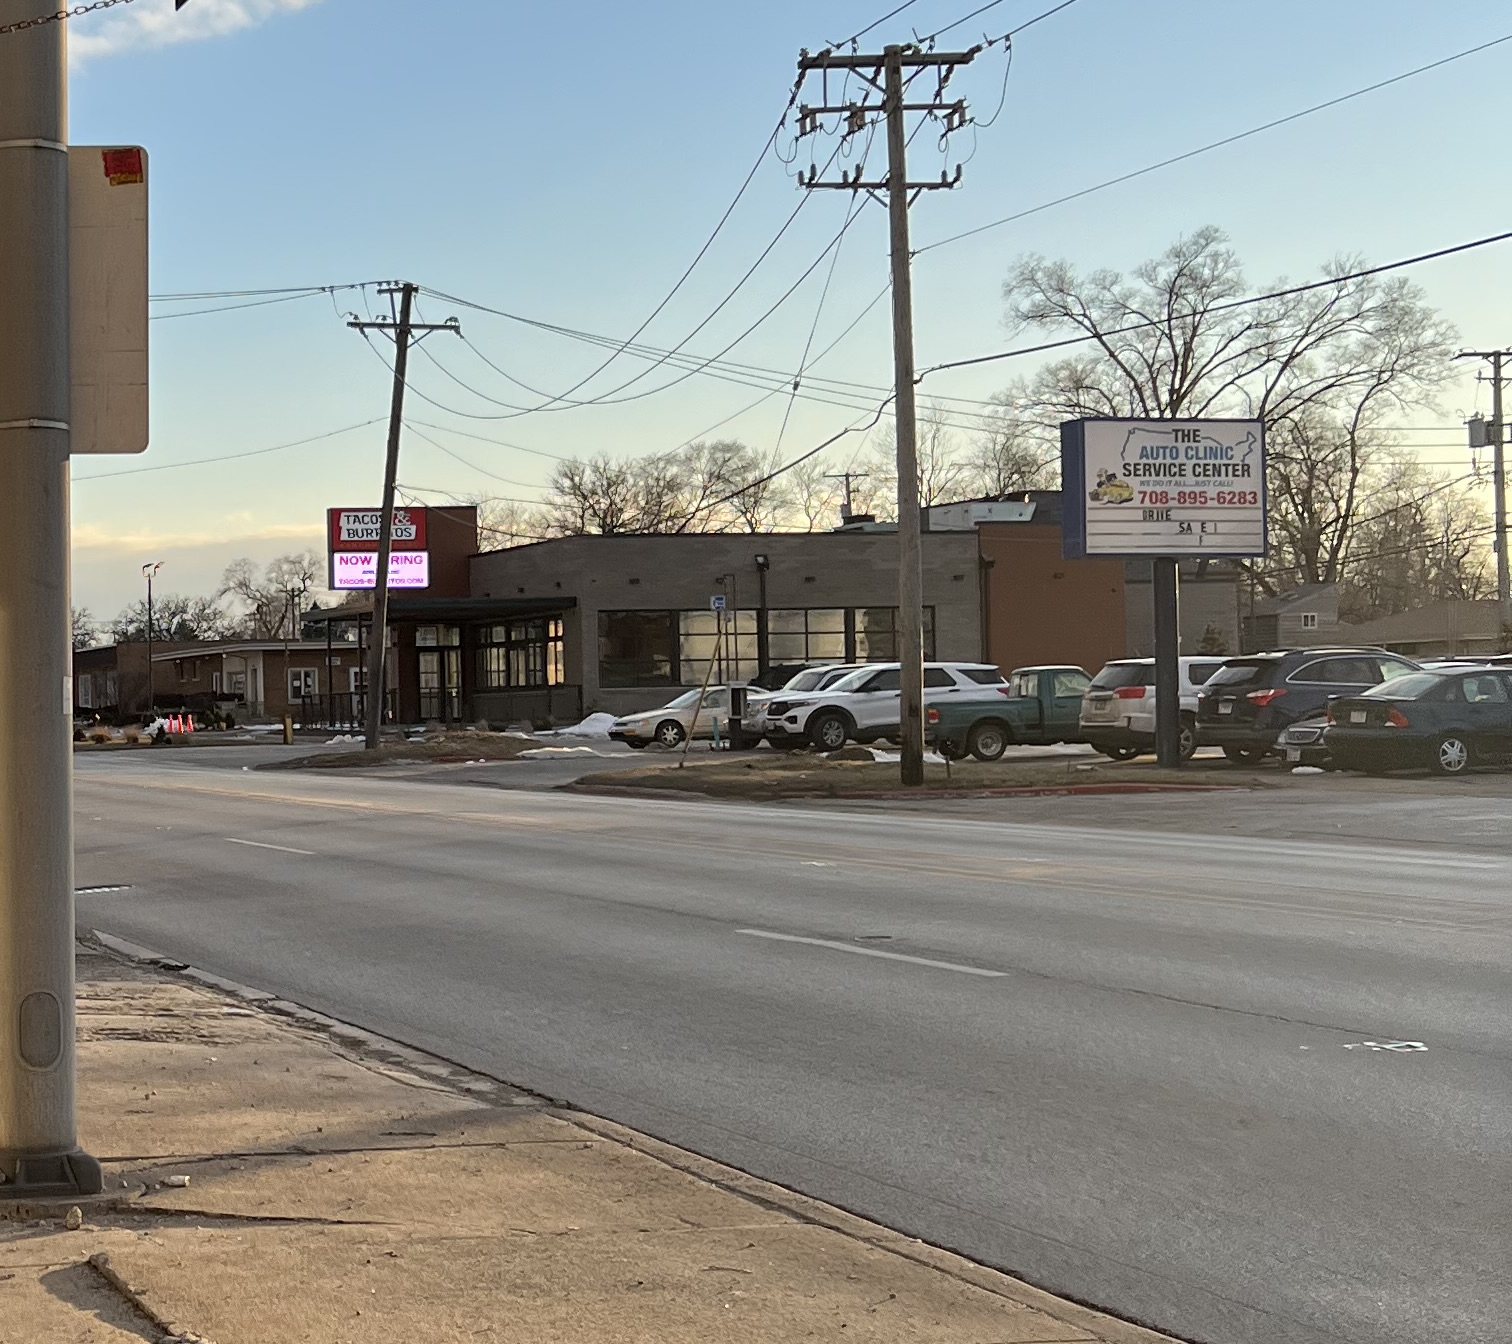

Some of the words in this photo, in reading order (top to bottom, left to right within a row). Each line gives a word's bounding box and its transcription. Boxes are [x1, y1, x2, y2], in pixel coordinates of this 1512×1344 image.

[1171, 428, 1201, 443] THE
[1139, 446, 1180, 460] AUTO
[1184, 446, 1234, 460] CLINIC
[1122, 463, 1187, 477] SERVICE
[1192, 463, 1251, 477] CENTER
[1138, 490, 1258, 505] 708-895-6283
[339, 555, 372, 566] NOW
